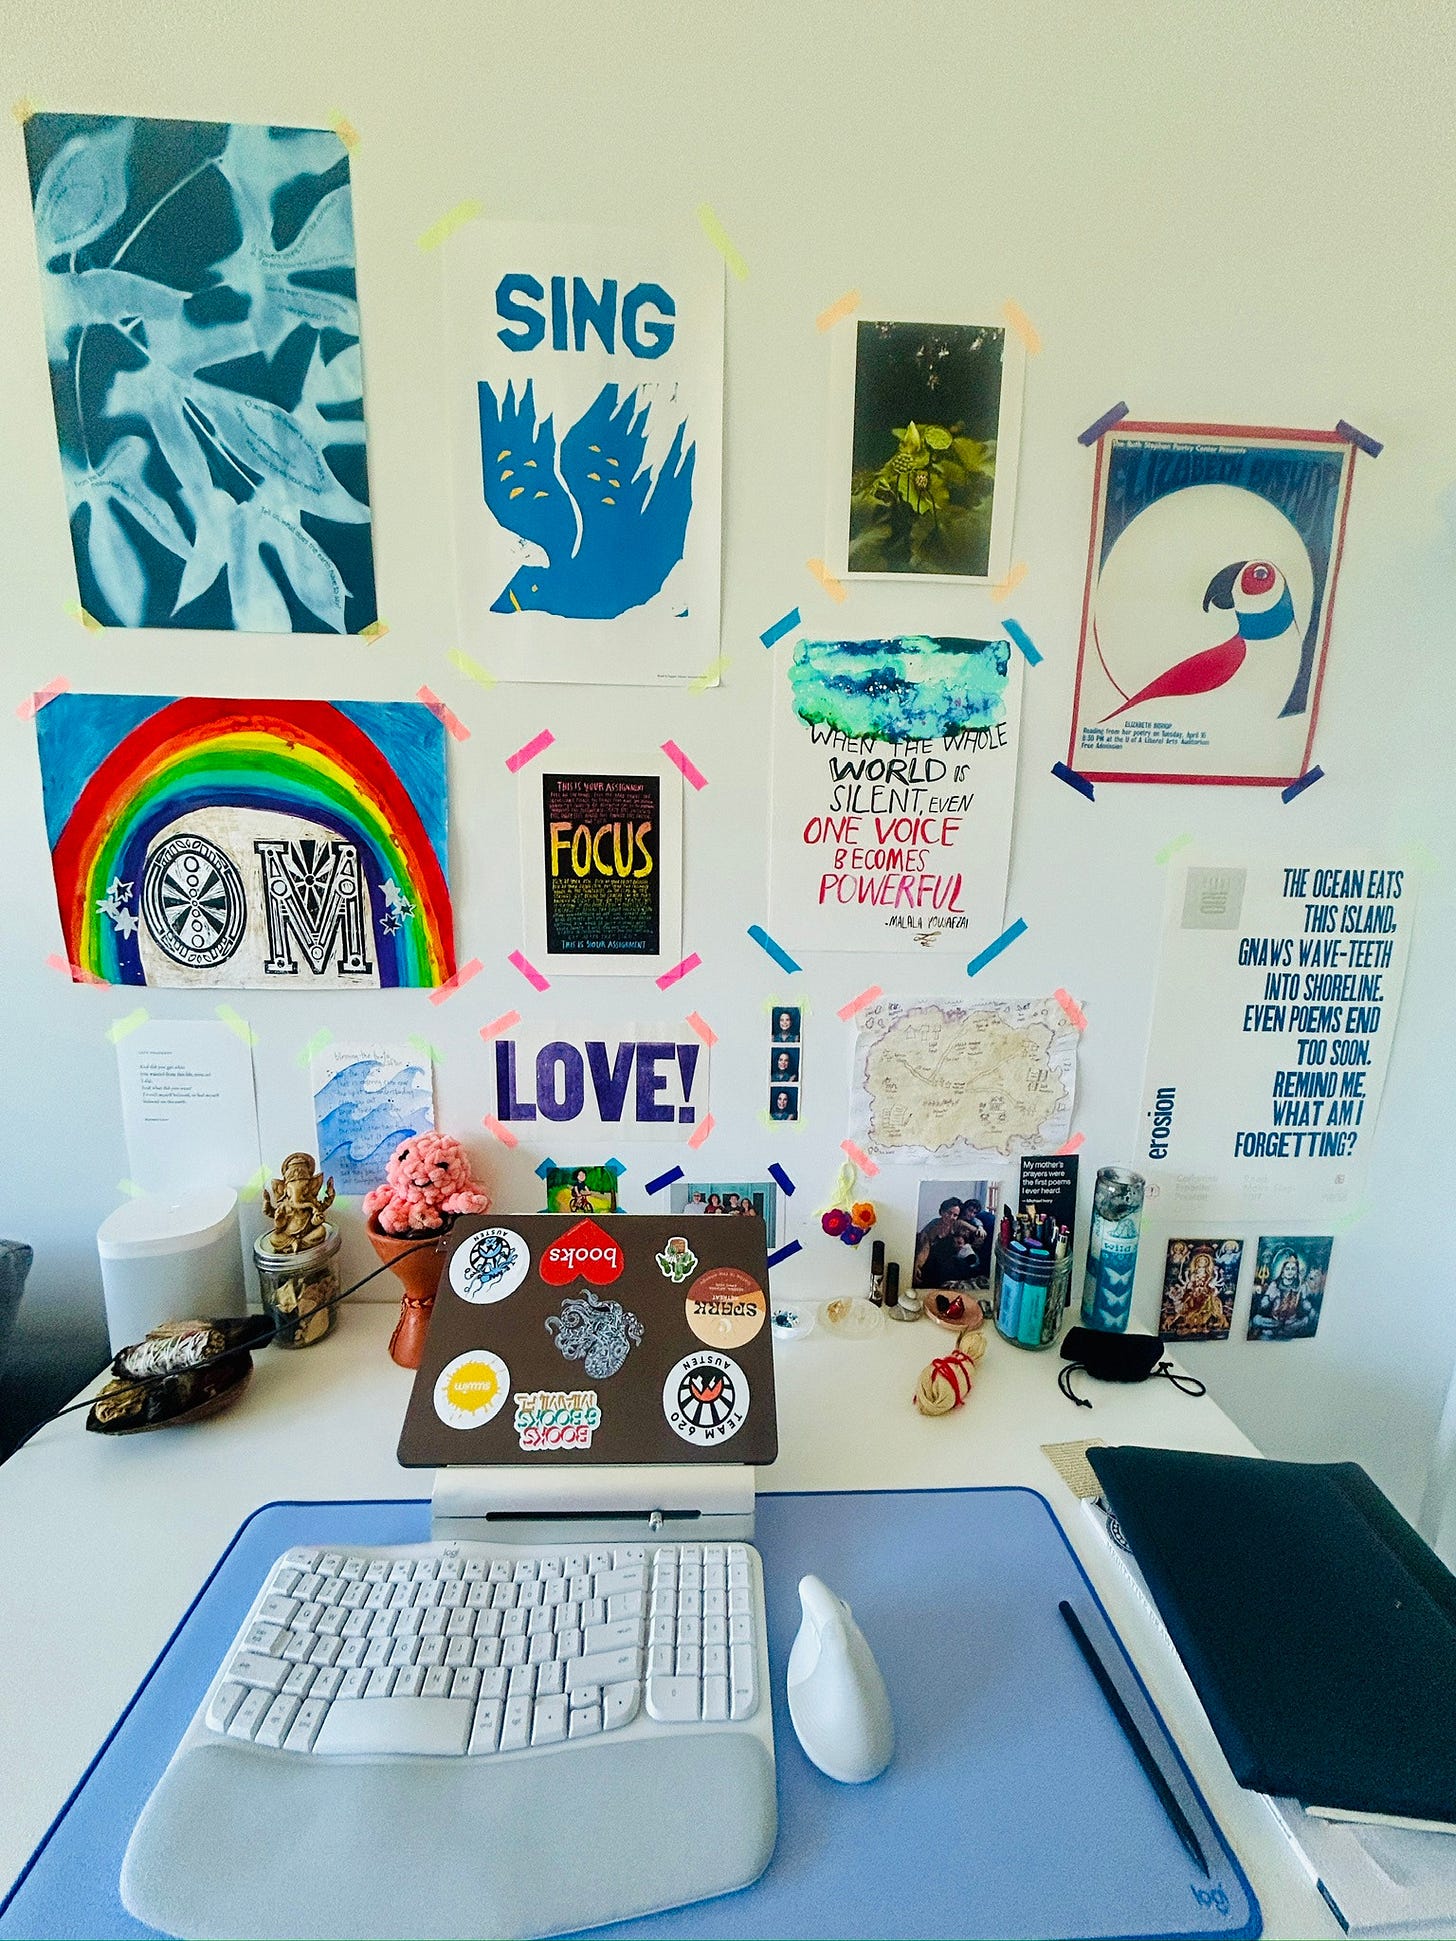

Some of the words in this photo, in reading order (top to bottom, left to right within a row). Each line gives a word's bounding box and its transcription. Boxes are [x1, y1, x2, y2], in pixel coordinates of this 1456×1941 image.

[495, 274, 676, 360] SING
[811, 724, 875, 755] WHEN
[944, 722, 1008, 754] WHOLE
[829, 757, 947, 785] WORLD
[954, 764, 971, 783] IS
[557, 781, 573, 792] THIS
[574, 782, 582, 791] IS
[583, 782, 604, 792] YOUR
[605, 783, 644, 792] ASSIGNMENT
[830, 784, 928, 816] SILENT,
[929, 793, 974, 814] EVEN
[803, 816, 863, 845] ONE
[875, 817, 964, 847] VOICE
[550, 821, 653, 879] FOCUS
[834, 848, 930, 873] BECOMES
[819, 873, 965, 913] POWERFUL
[1283, 868, 1310, 898] THE
[1312, 868, 1364, 900] OCEAN
[1366, 870, 1404, 900] EATS
[1304, 904, 1337, 934] THIS
[1340, 904, 1397, 935] ISLAND,
[562, 940, 576, 949] THIS
[577, 940, 584, 948] IS
[586, 940, 606, 949] YOUR
[607, 940, 646, 949] ASSIGNMENT
[1238, 937, 1294, 967] GNAWS
[1299, 939, 1394, 969] WAVE-TEETH
[1264, 972, 1300, 1001] INTO
[1302, 974, 1384, 1002] SHORELINE.
[1242, 1004, 1286, 1032] EVEN
[1288, 1005, 1344, 1033] POEMS
[1345, 1006, 1381, 1033] END
[1297, 1039, 1328, 1066] TOO
[1330, 1039, 1372, 1066] SOON.
[496, 1040, 700, 1123] LOVE!
[1272, 1071, 1338, 1098] REMIND
[1340, 1071, 1367, 1099] ME,
[1148, 1086, 1176, 1160] erosion
[1272, 1100, 1321, 1127] WHAT
[1326, 1100, 1351, 1127] AM
[1355, 1100, 1365, 1126] I
[1234, 1132, 1357, 1158] FORGETTING?
[1023, 1161, 1034, 1170] My
[1034, 1161, 1064, 1169] mother's
[1023, 1171, 1048, 1179] prayers
[1022, 1178, 1034, 1186] the
[1034, 1178, 1048, 1186] first
[1048, 1179, 1071, 1187] poems
[474, 1229, 509, 1242] AUSTEN
[549, 1247, 617, 1269] books
[693, 1300, 757, 1317] SPARK
[682, 1356, 731, 1371] AUSTEN
[541, 1393, 593, 1411] MIAMI
[517, 1408, 583, 1428] BOOKS
[670, 1412, 696, 1436] 620
[704, 1412, 743, 1440] TEAM
[522, 1425, 589, 1447] BOOKS
[443, 1548, 460, 1559] logi
[1190, 1882, 1229, 1916] logi
